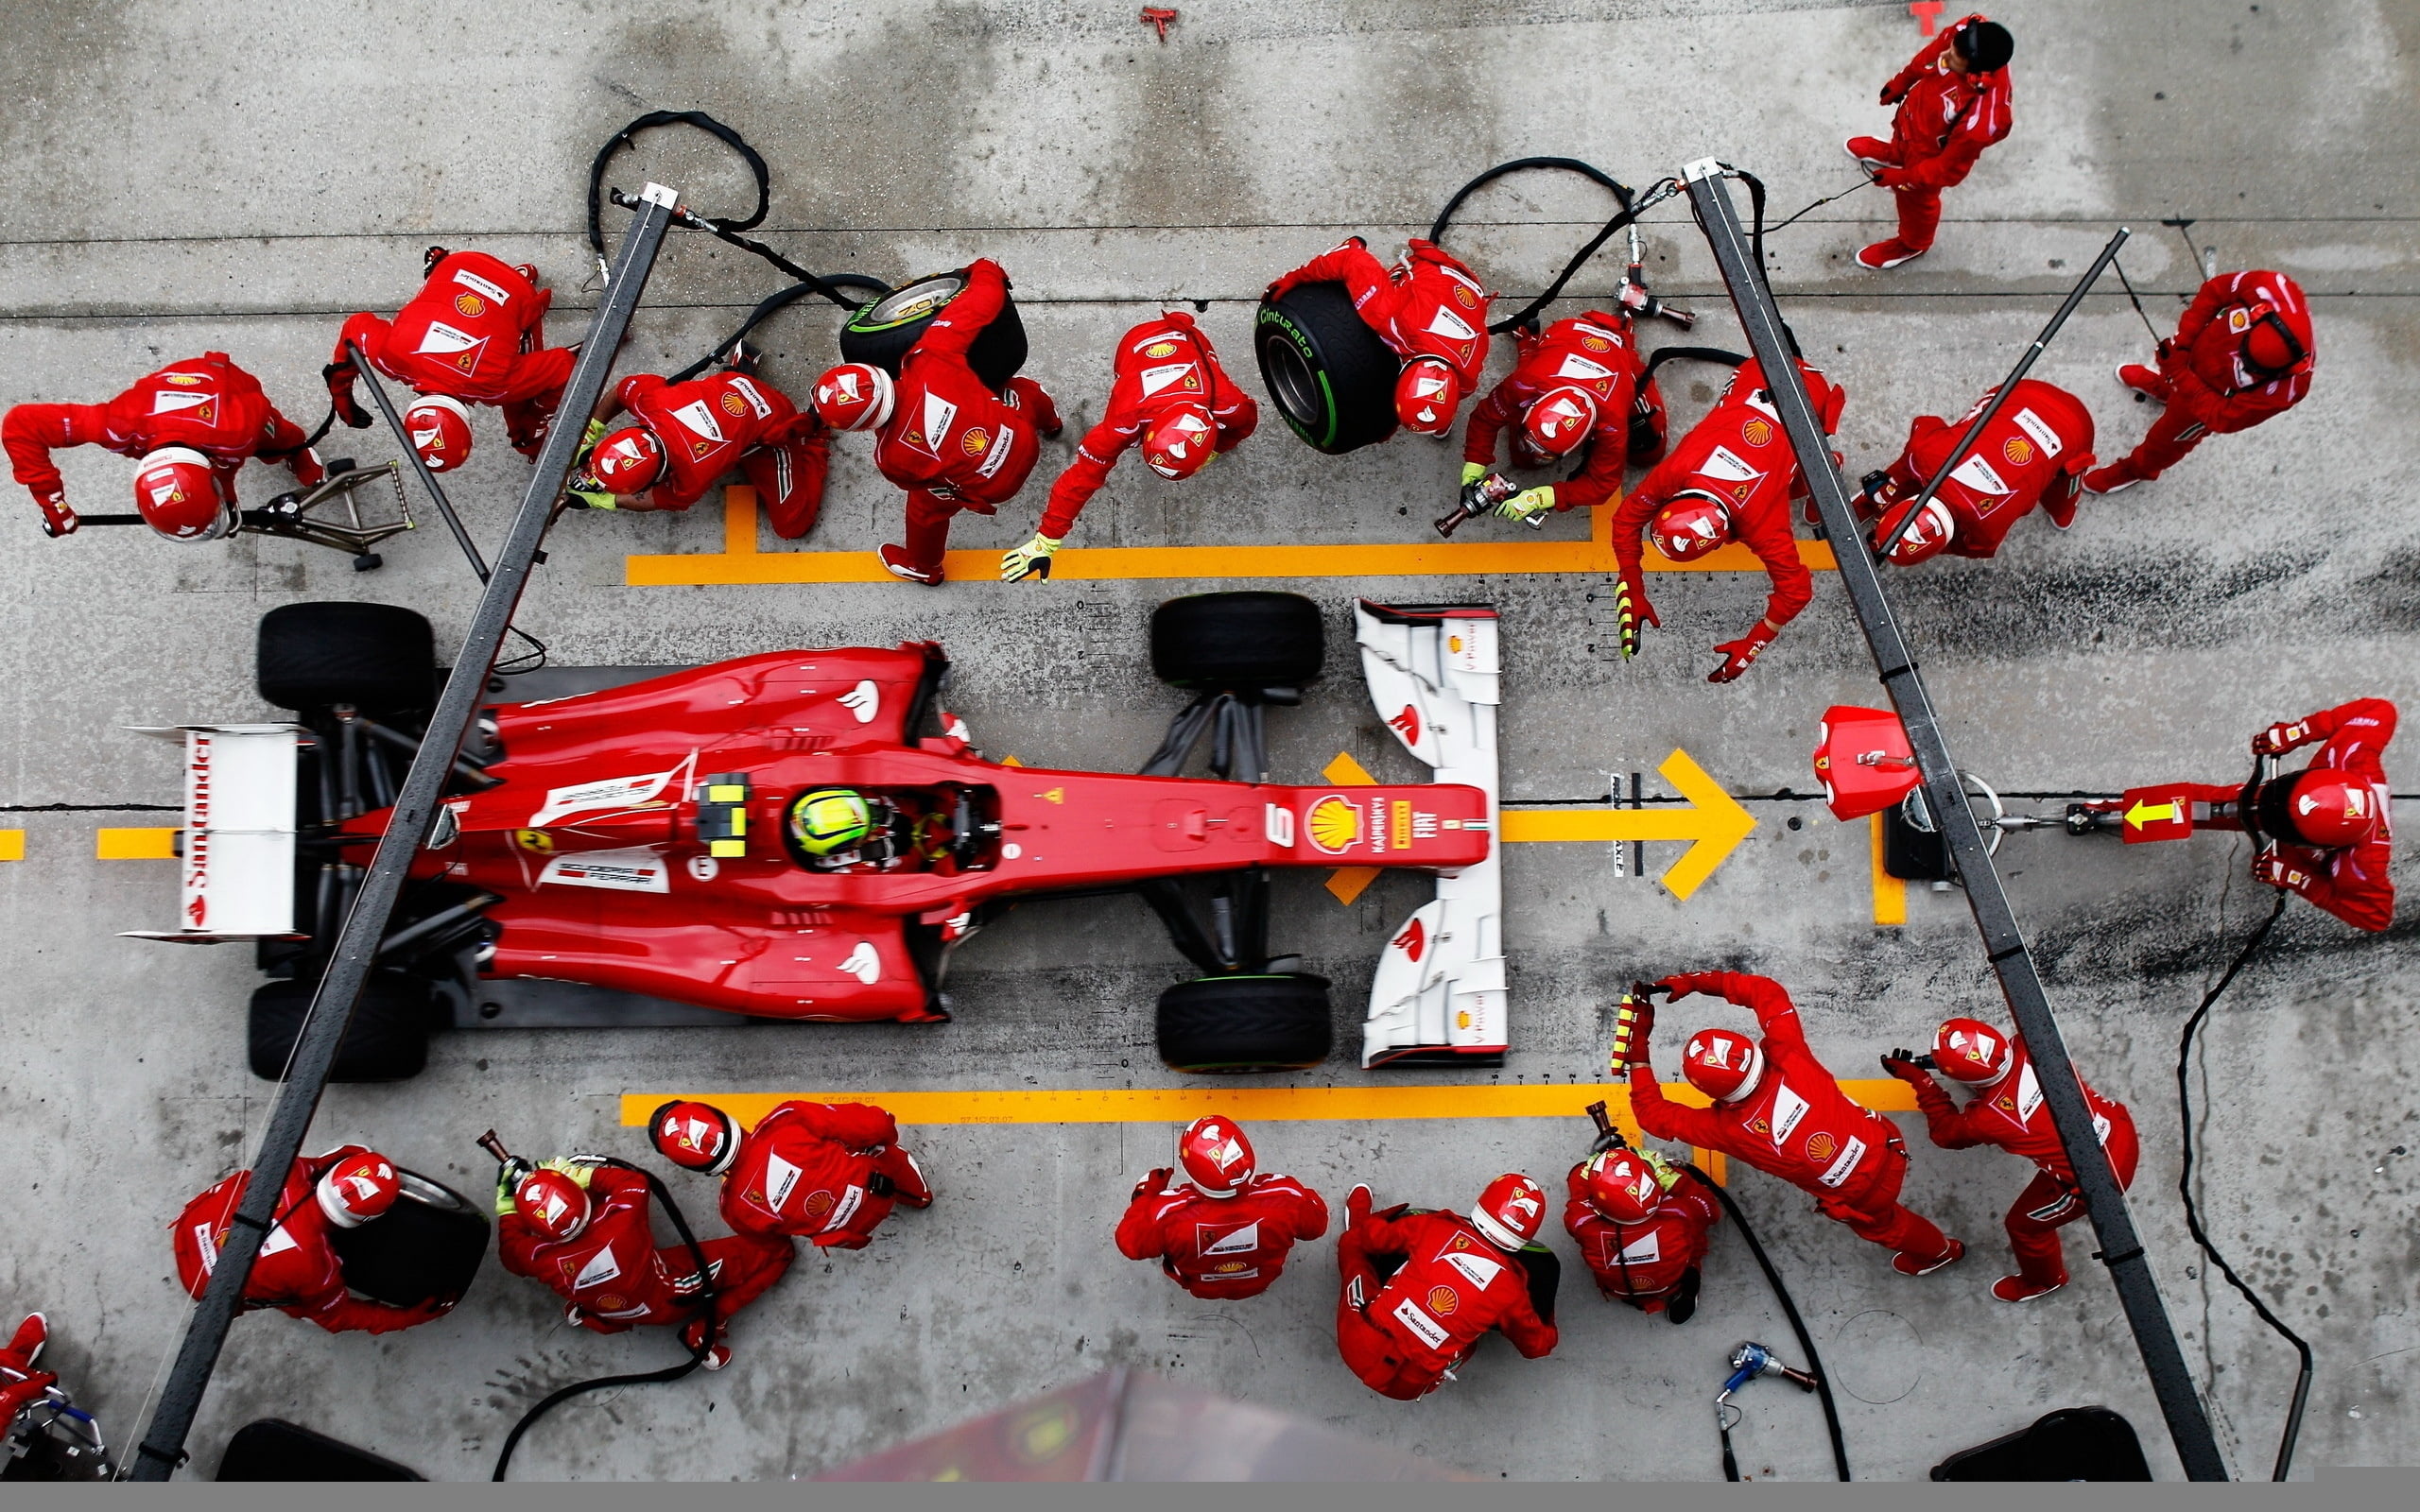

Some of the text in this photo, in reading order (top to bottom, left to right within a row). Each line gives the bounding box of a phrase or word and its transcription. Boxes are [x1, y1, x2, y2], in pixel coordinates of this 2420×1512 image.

[989, 430, 1011, 470] Santander
[1077, 601, 1084, 610] 0
[187, 735, 211, 888] Santander
[1266, 802, 1295, 848] 6
[1412, 812, 1437, 838] FIAT
[1121, 1059, 1129, 1068] 0
[1834, 1143, 1861, 1180] Santander
[1406, 1311, 1442, 1344] Santander
